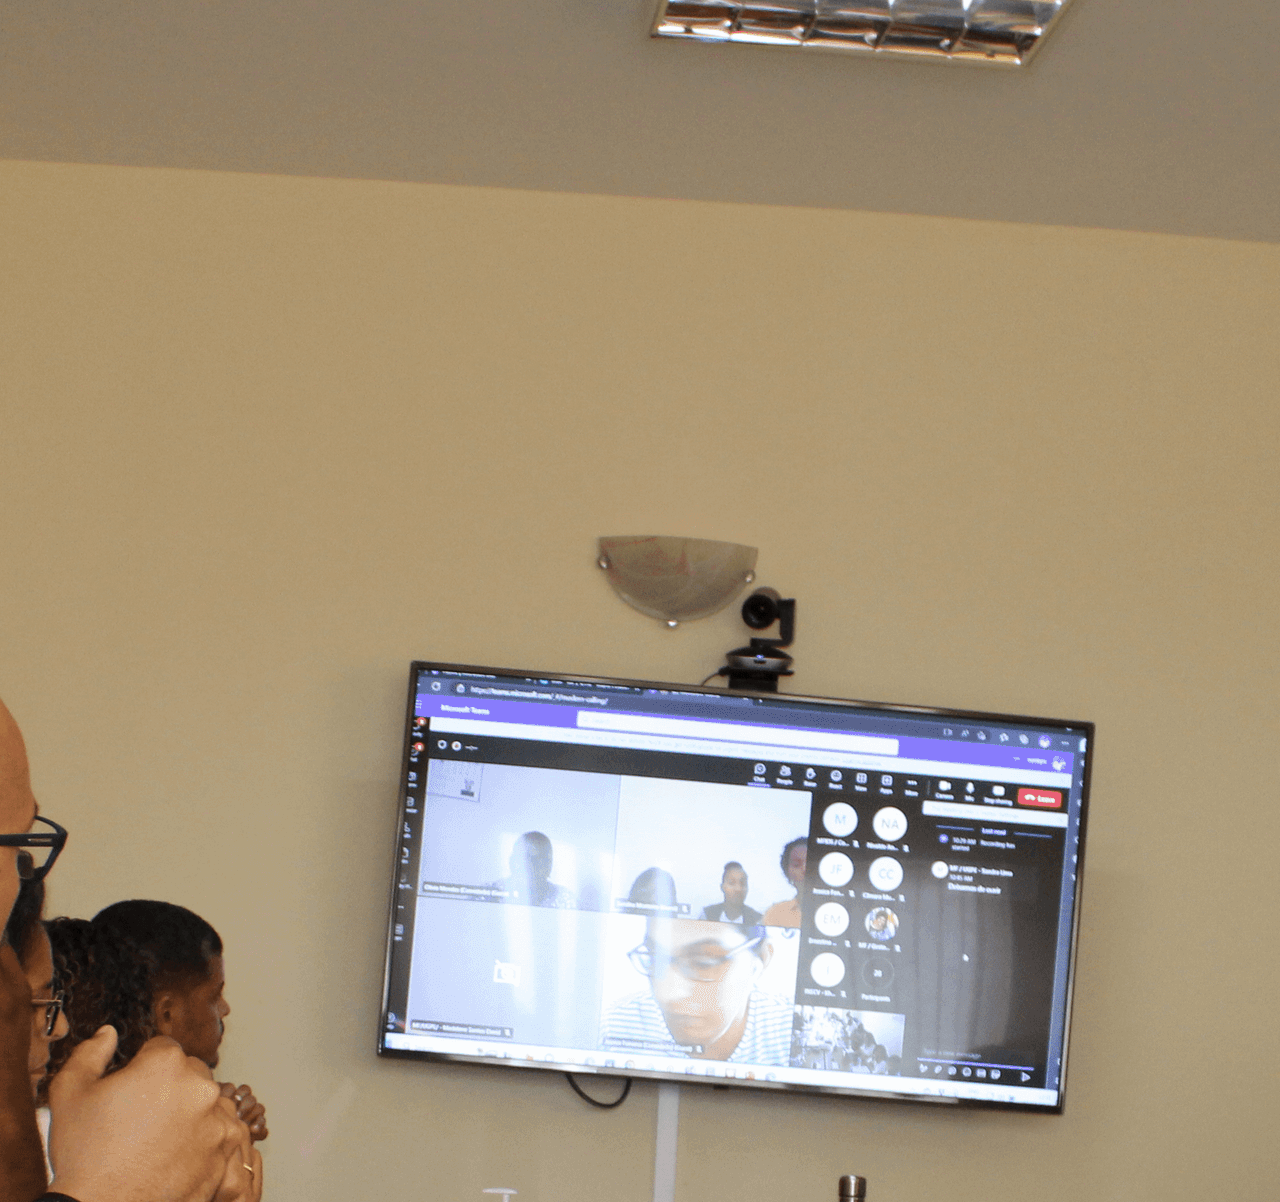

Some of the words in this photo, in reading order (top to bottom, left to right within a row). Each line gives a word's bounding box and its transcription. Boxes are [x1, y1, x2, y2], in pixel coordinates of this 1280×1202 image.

[834, 814, 847, 825] M
[881, 818, 900, 830] NA
[878, 868, 895, 880] CC
